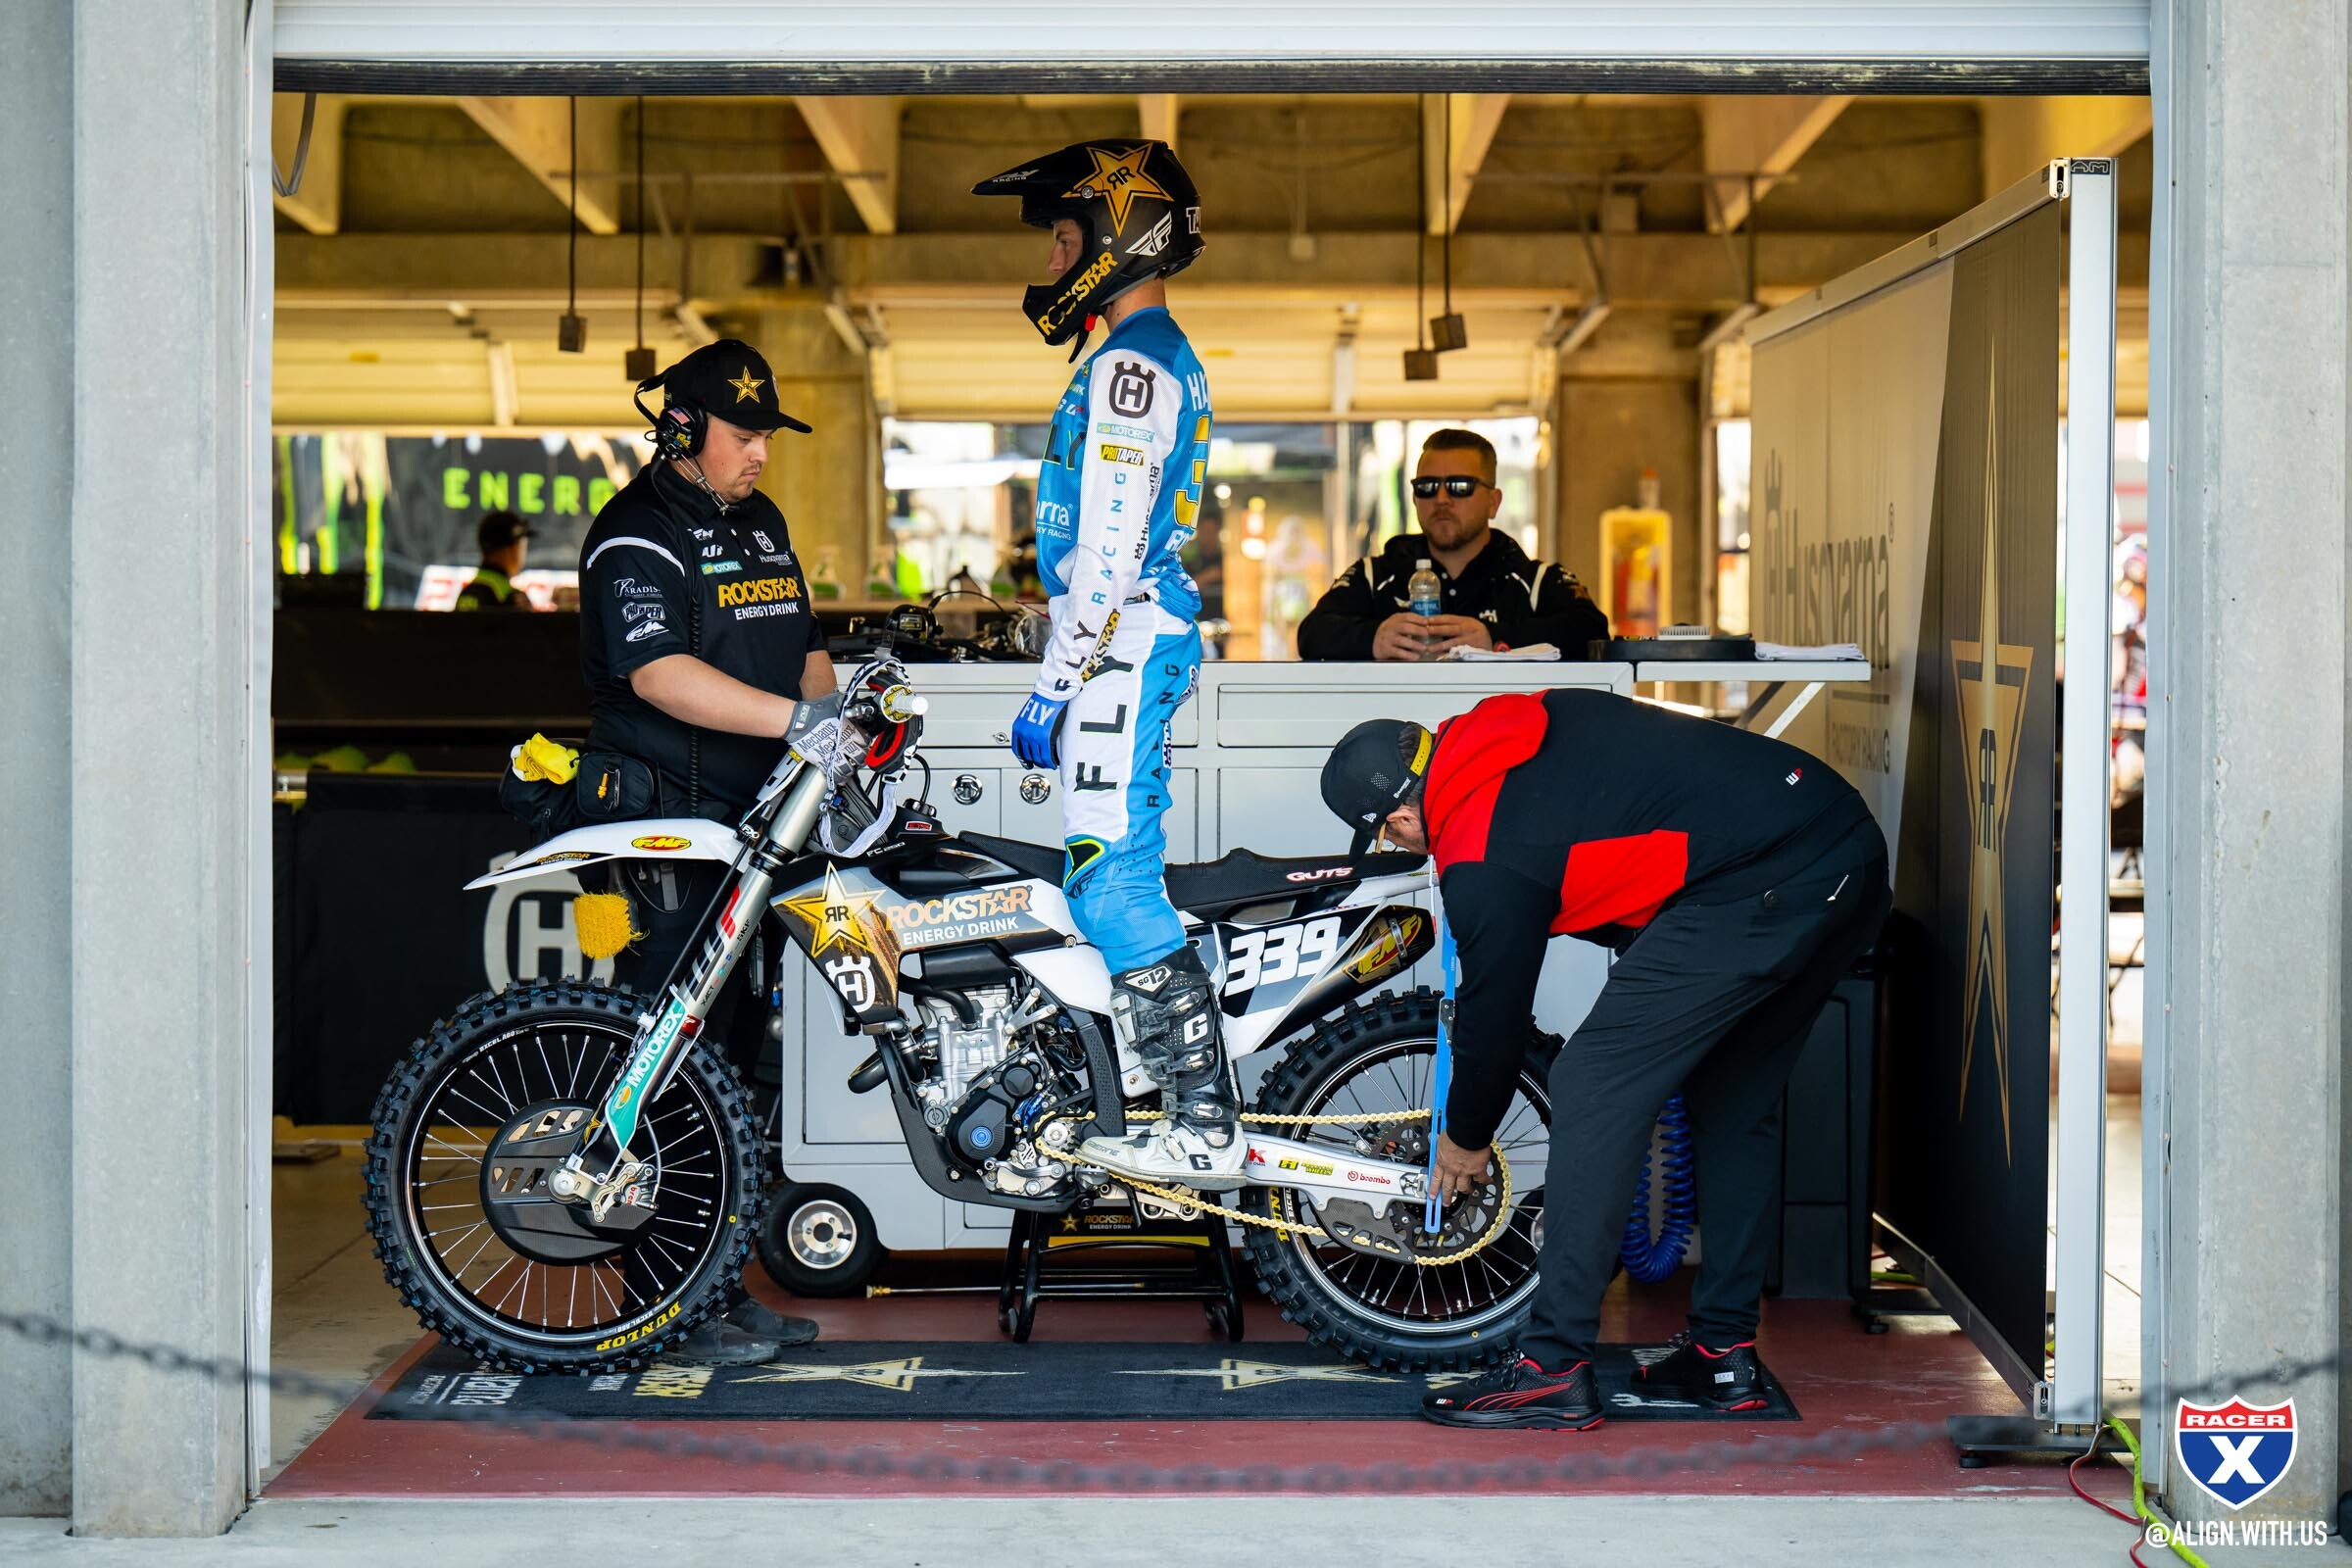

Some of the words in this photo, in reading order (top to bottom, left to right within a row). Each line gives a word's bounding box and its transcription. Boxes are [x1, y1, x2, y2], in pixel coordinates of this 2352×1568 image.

[1110, 424, 1153, 441] MOTOREX
[718, 576, 801, 608] ROCKSTAR
[1020, 698, 1055, 727] FLY
[797, 721, 837, 754] Mechanix
[633, 837, 691, 850] FMF
[1286, 866, 1354, 882] GUTS
[886, 887, 1030, 929] ROCKSTAR
[903, 924, 965, 947] ENERGY
[967, 916, 1020, 937] DRINK
[1225, 915, 1342, 998] 339
[625, 1010, 684, 1088] MOTOREX
[1359, 1173, 1392, 1185] brembo
[596, 1300, 682, 1352] DUNLOP
